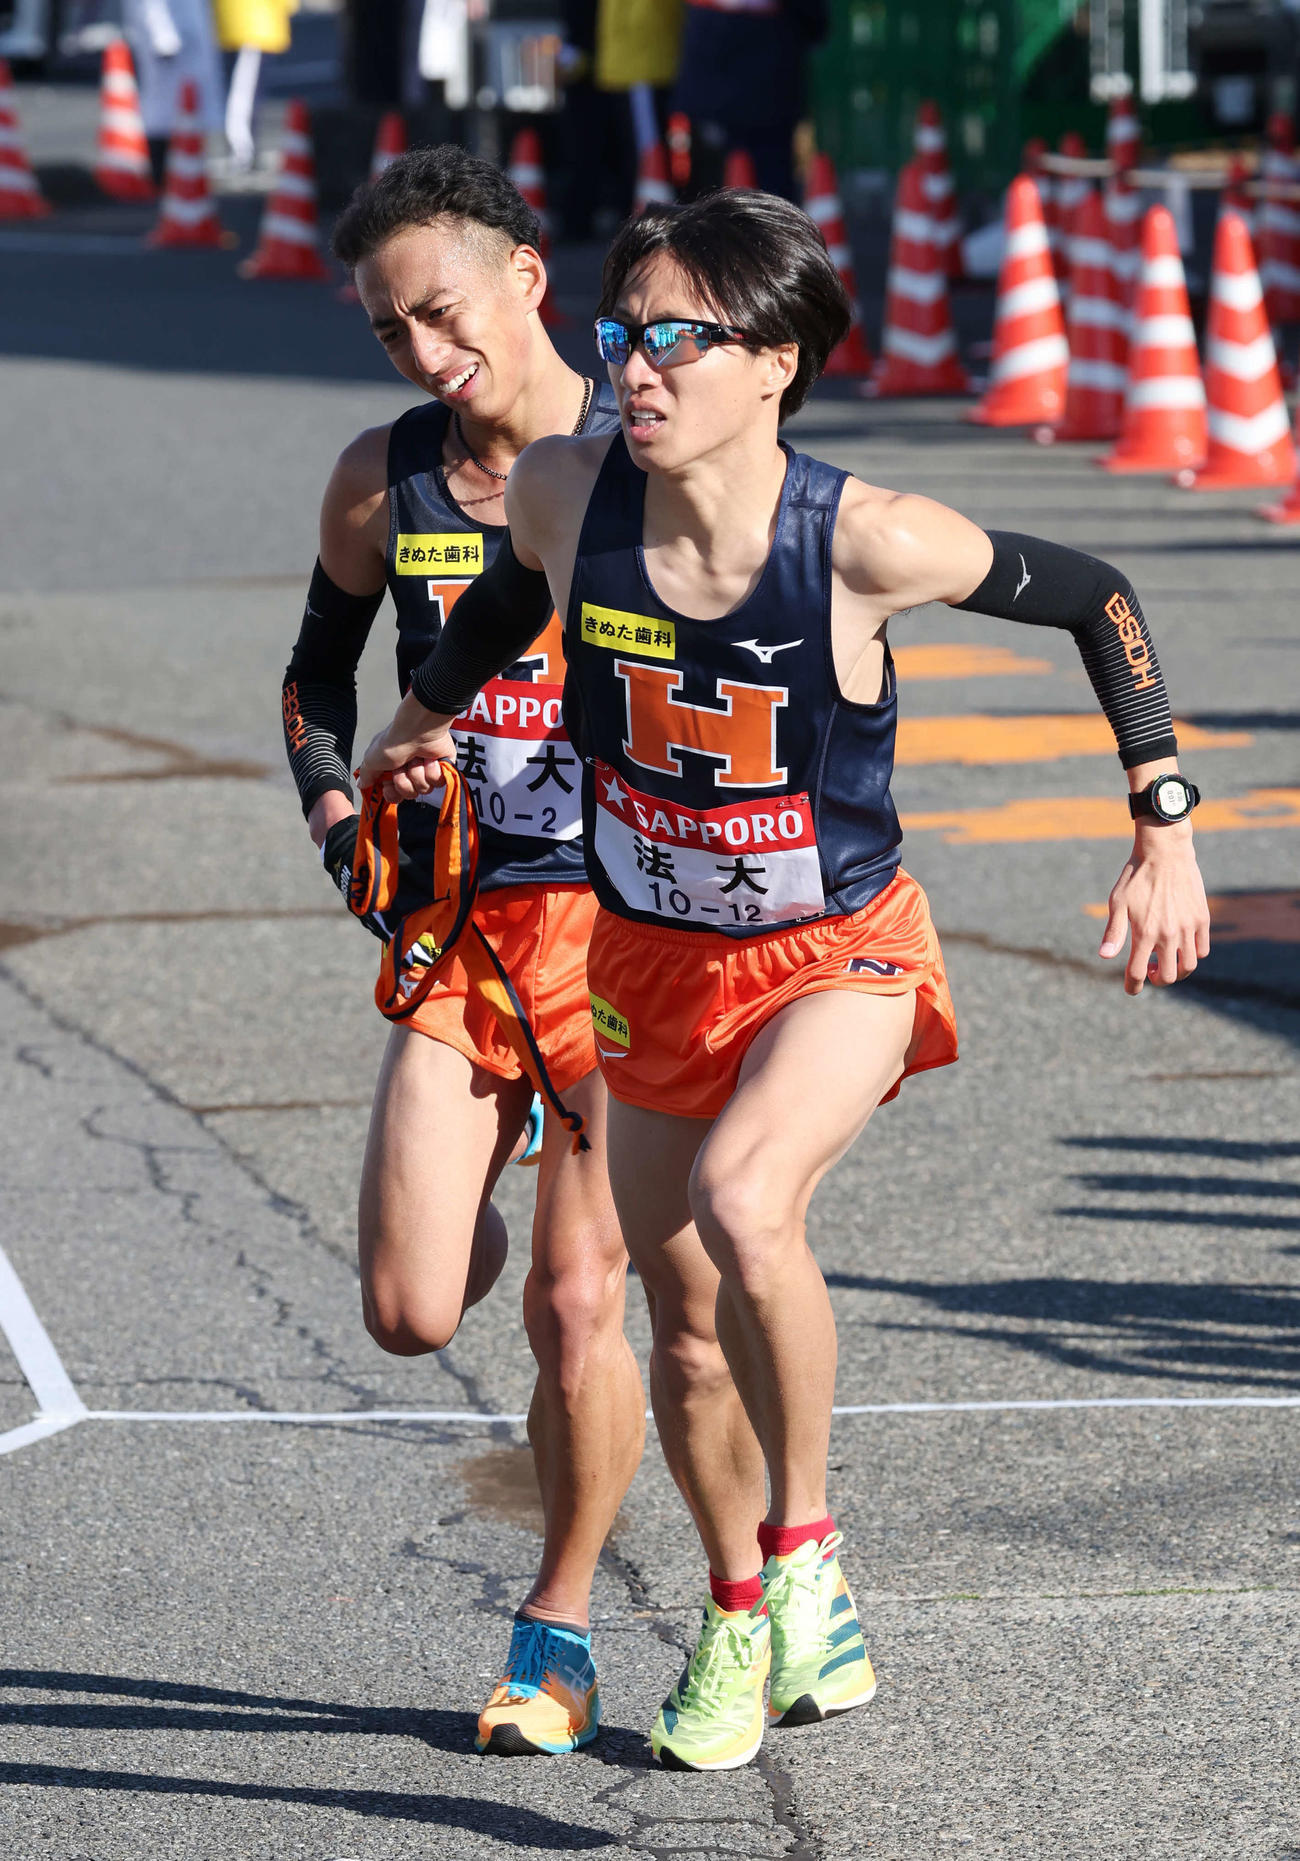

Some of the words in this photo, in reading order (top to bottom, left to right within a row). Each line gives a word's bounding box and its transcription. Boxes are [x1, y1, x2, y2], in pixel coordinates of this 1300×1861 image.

[399, 545, 480, 563] きぬた歯科
[584, 616, 672, 648] きぬた歯科
[456, 691, 564, 729] APPO
[614, 658, 789, 789] H
[632, 800, 804, 846] SAPPORO
[649, 881, 763, 922] 10-12
